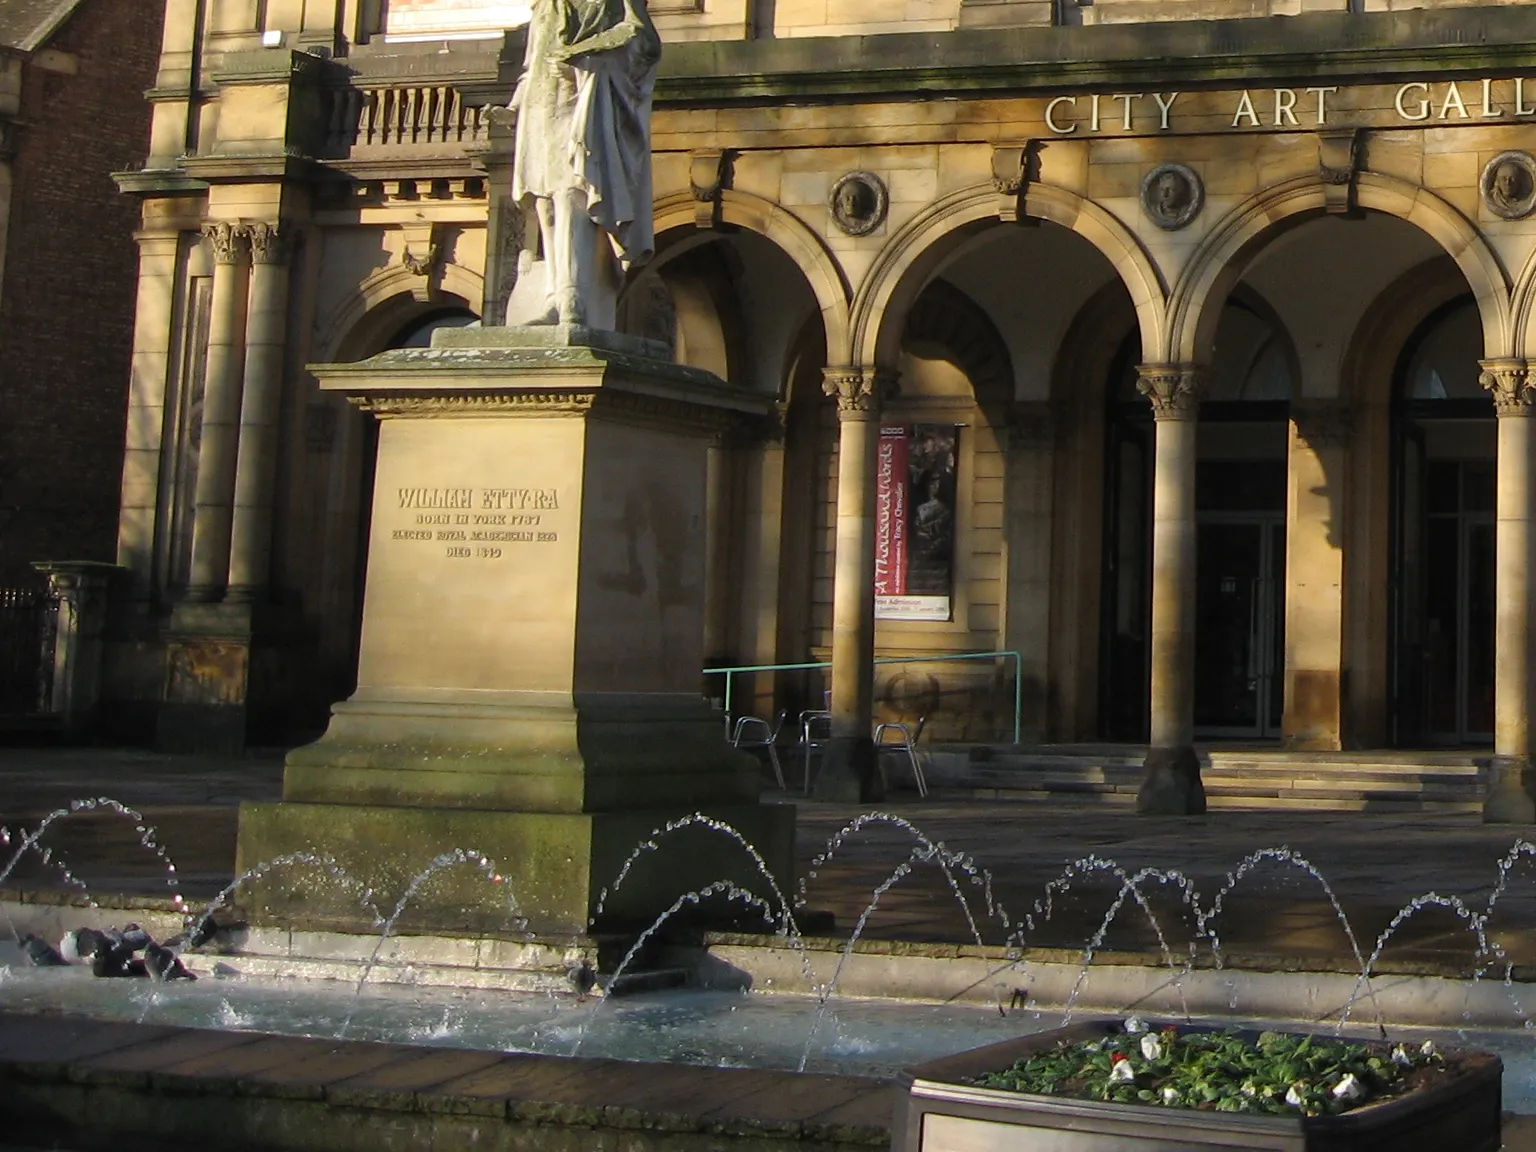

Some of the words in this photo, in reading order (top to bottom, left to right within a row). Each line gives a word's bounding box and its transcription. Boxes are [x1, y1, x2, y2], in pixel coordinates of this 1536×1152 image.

[1044, 91, 1180, 135] CITY
[1231, 86, 1339, 128] ART
[878, 443, 893, 490] Words
[398, 488, 473, 509] WILLIAM
[416, 514, 451, 525] BORN
[454, 514, 470, 525] IN
[472, 514, 507, 525] YORK
[893, 518, 904, 541] Tracy
[874, 490, 891, 575] Thousand
[446, 547, 472, 558] DIED
[874, 580, 889, 595] A
